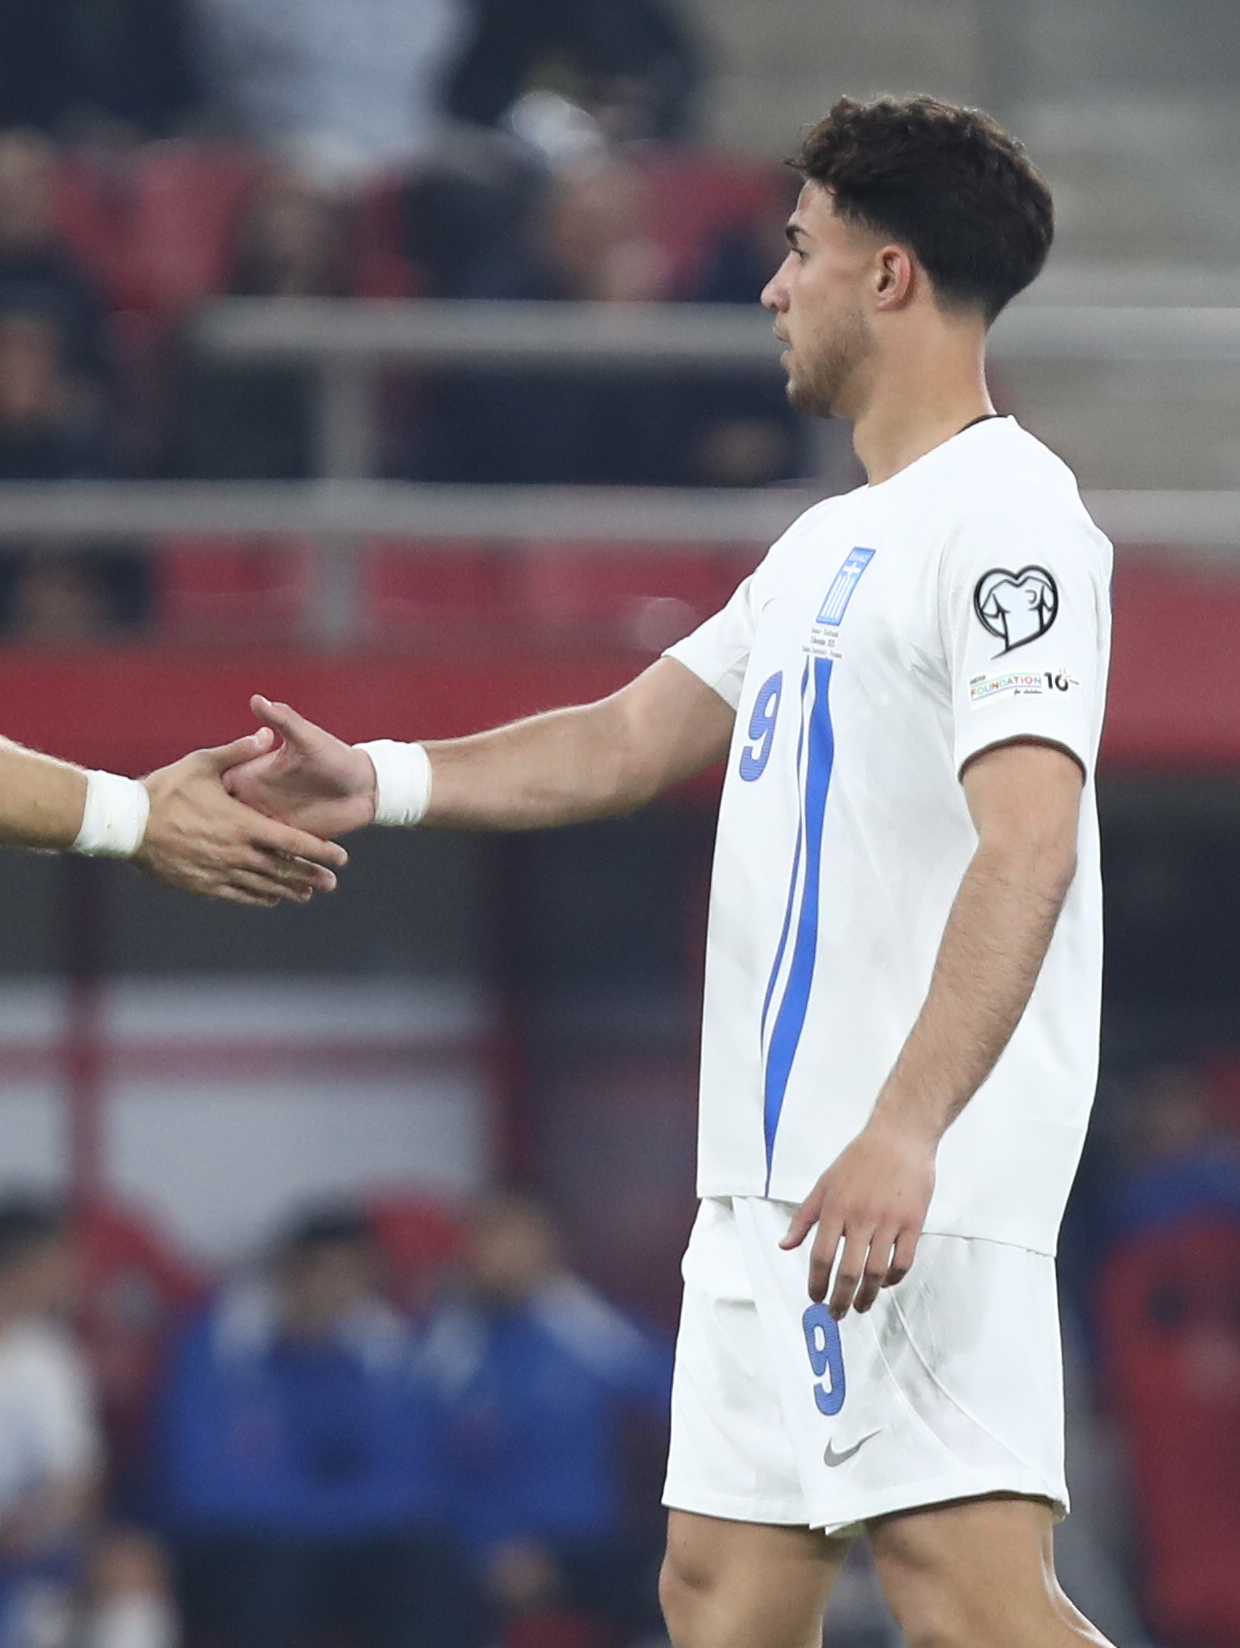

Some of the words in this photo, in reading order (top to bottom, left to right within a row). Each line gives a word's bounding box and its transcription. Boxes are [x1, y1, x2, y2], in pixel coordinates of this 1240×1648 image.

[739, 669, 784, 782] 9
[970, 675, 1042, 696] FOUNDATION
[802, 1302, 846, 1417] 9
